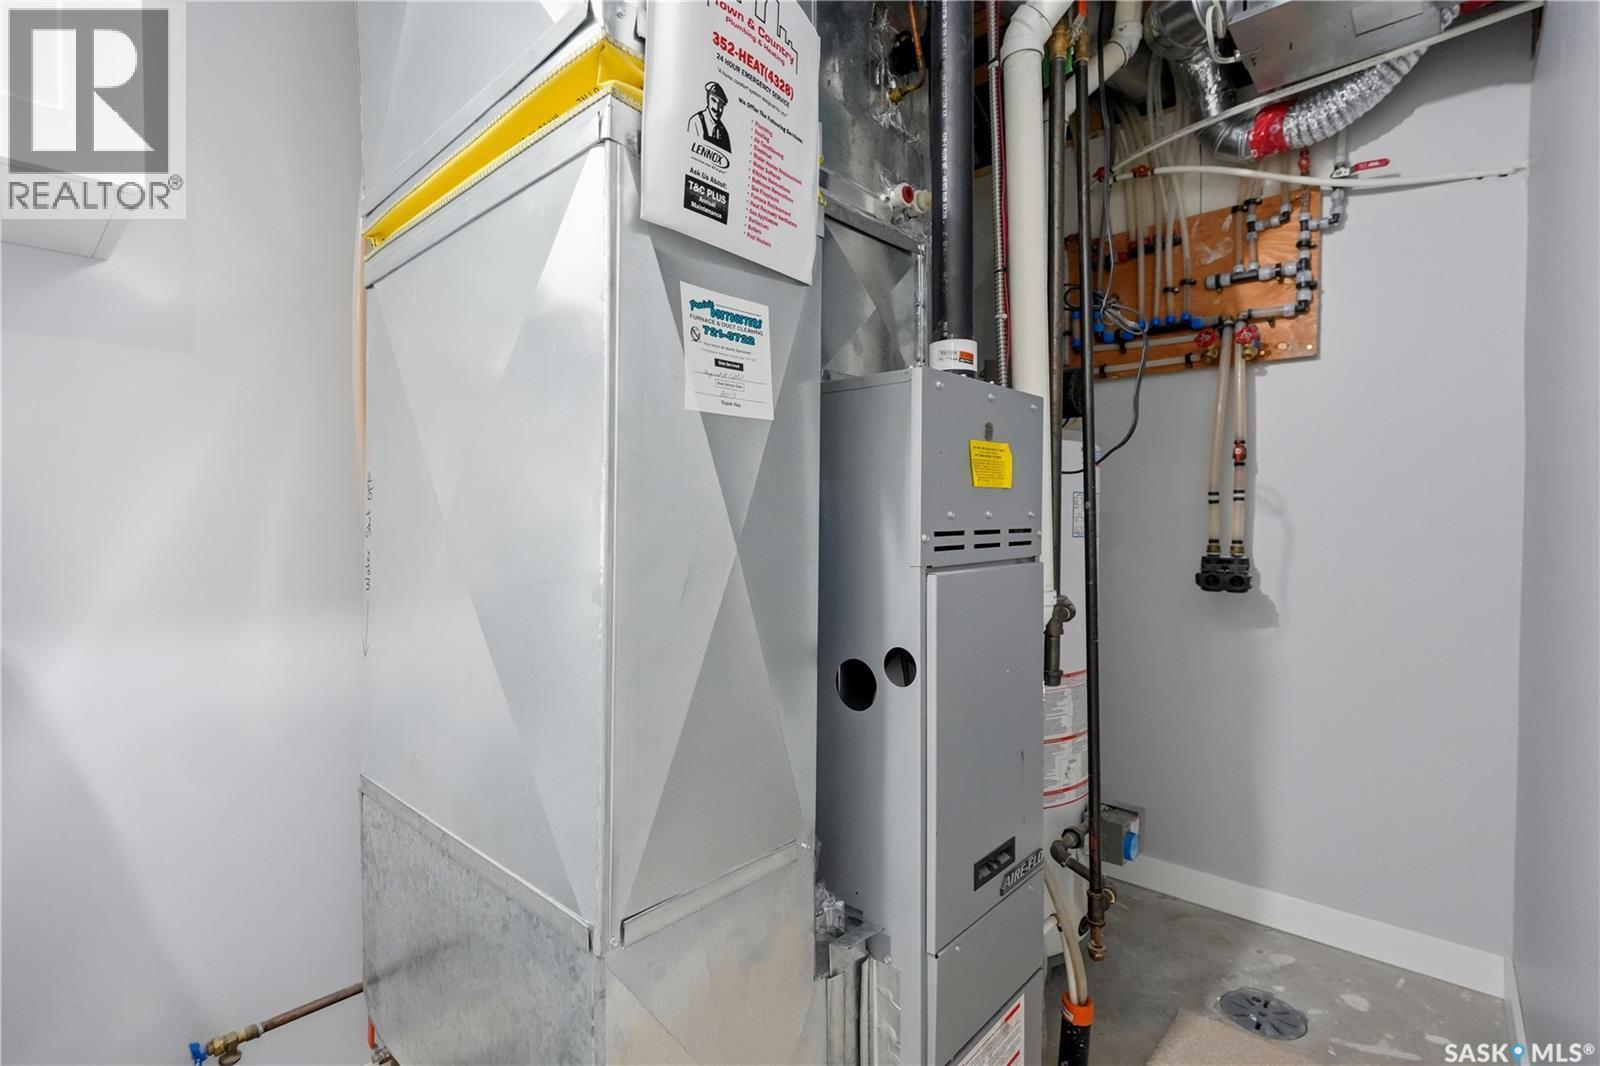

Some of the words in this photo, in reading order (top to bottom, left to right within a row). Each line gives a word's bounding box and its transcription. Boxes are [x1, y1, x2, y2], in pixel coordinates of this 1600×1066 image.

[726, 15, 757, 43] Plumbing
[763, 44, 785, 66] Heating
[747, 18, 755, 31] &
[758, 26, 794, 65] Country
[712, 31, 794, 101] 352-HEAT(4328)
[716, 53, 723, 62] 24
[725, 59, 741, 72] HOUR
[741, 69, 771, 95] EMERGENCY
[772, 90, 789, 108] SERVICE
[738, 97, 746, 106] We
[747, 102, 759, 114] Offer
[759, 109, 767, 119] The
[767, 115, 785, 133] Following
[691, 142, 724, 165] LENNOX
[688, 180, 706, 195] T&C
[706, 188, 727, 205] PLUS
[690, 167, 701, 176] Ask
[701, 172, 710, 181] Us
[690, 201, 722, 219] Maintenance
[689, 313, 716, 325] FURNACE
[722, 322, 737, 331] DUCT
[737, 327, 764, 336] CLEANING
[363, 549, 372, 591] Water
[1004, 849, 1045, 888] AIRE-FLO
